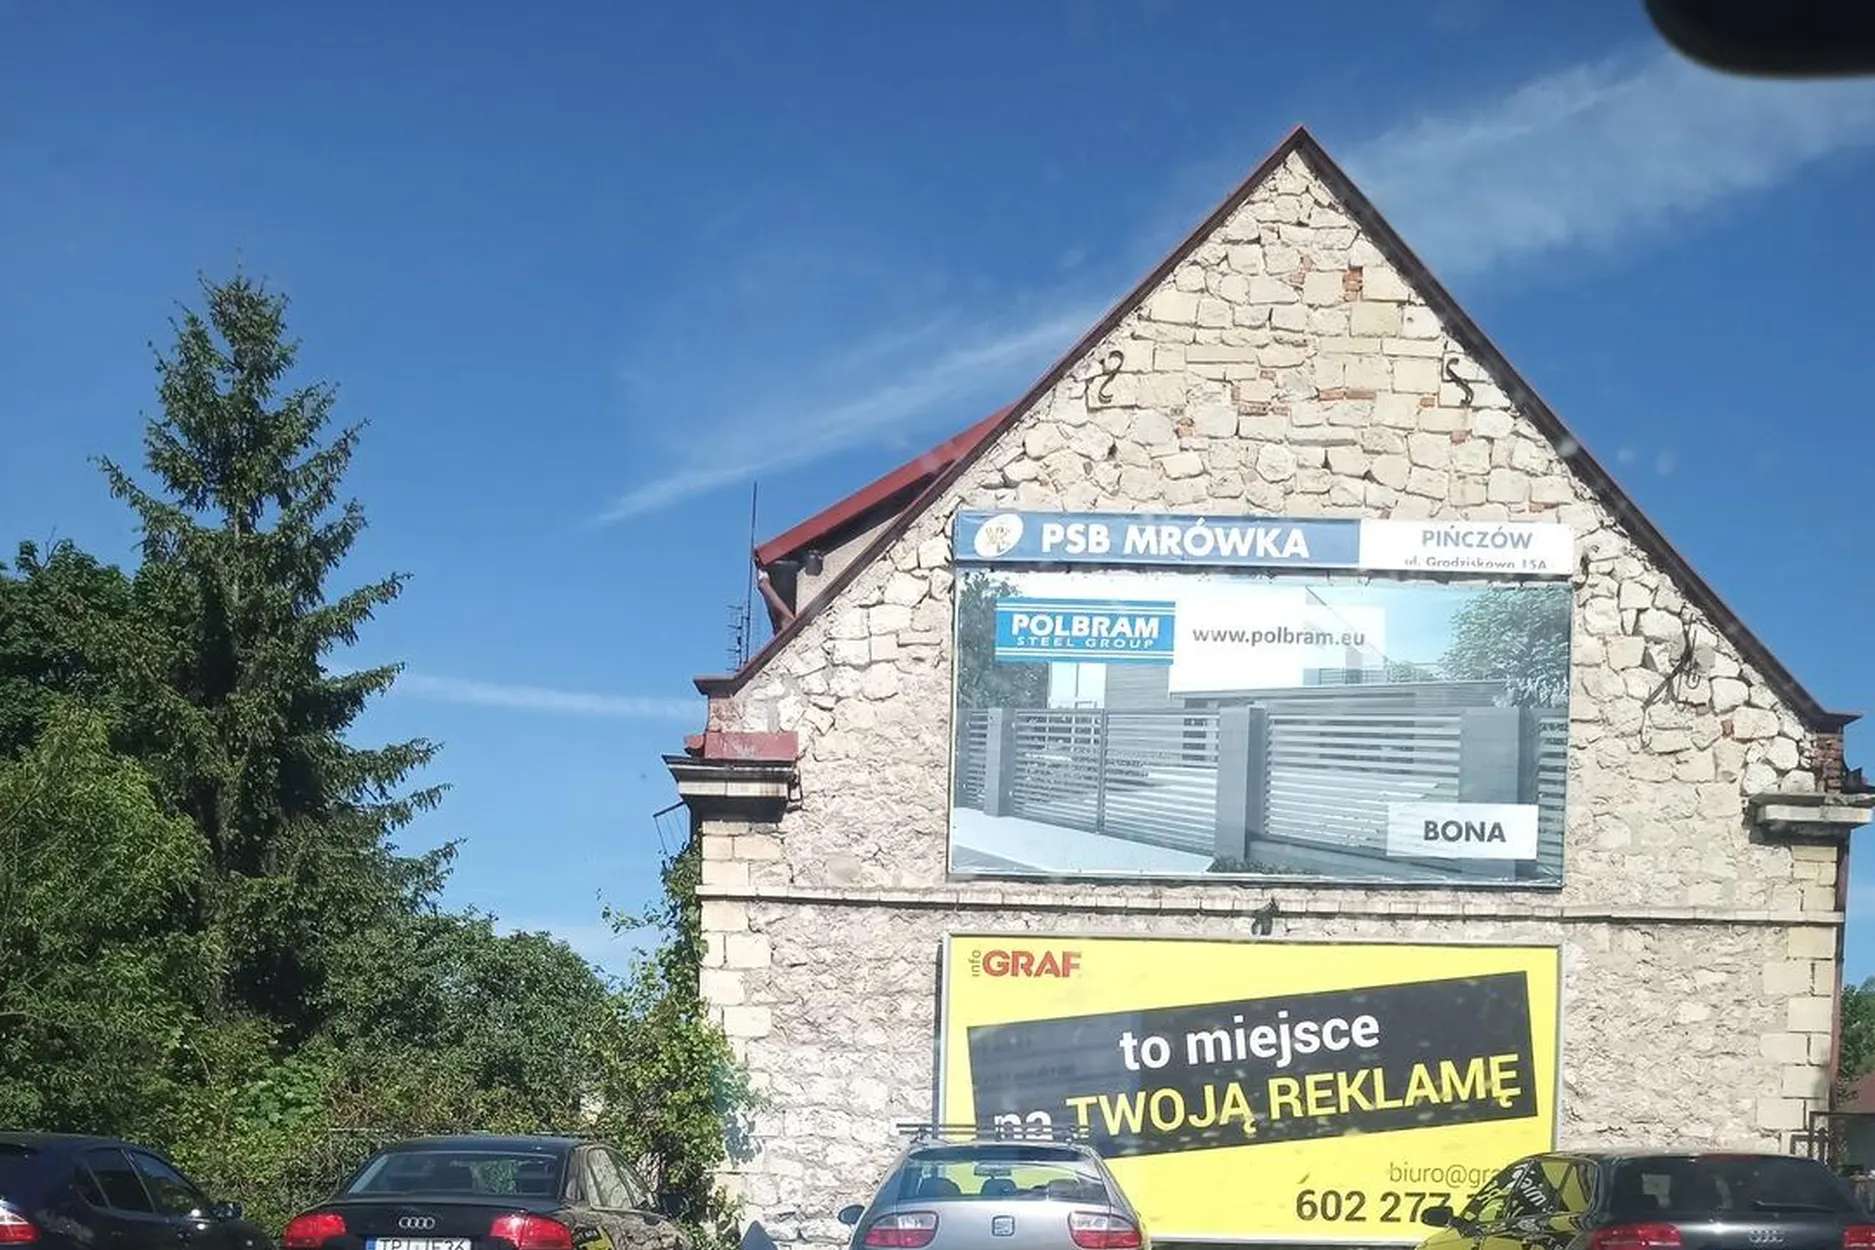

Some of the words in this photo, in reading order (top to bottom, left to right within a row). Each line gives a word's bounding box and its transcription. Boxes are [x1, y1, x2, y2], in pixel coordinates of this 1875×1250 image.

[1041, 523, 1111, 554] PSB
[1122, 517, 1311, 558] MRÓWKA
[1421, 525, 1533, 549] PIŃCZÓW
[1011, 614, 1160, 638] POLBRAM
[1192, 626, 1366, 647] www.polbram.eu
[1016, 636, 1075, 648] STEEL
[1085, 638, 1155, 650] GROUP
[1423, 820, 1507, 843] BONA
[967, 949, 981, 977] info
[982, 949, 1082, 978] GRAF
[1119, 1030, 1171, 1071] to
[1186, 1011, 1380, 1068] miejsce
[1066, 1082, 1258, 1138] TWOJĄ
[1267, 1053, 1522, 1119] REKLAMĘ
[1296, 1189, 1368, 1223] 602
